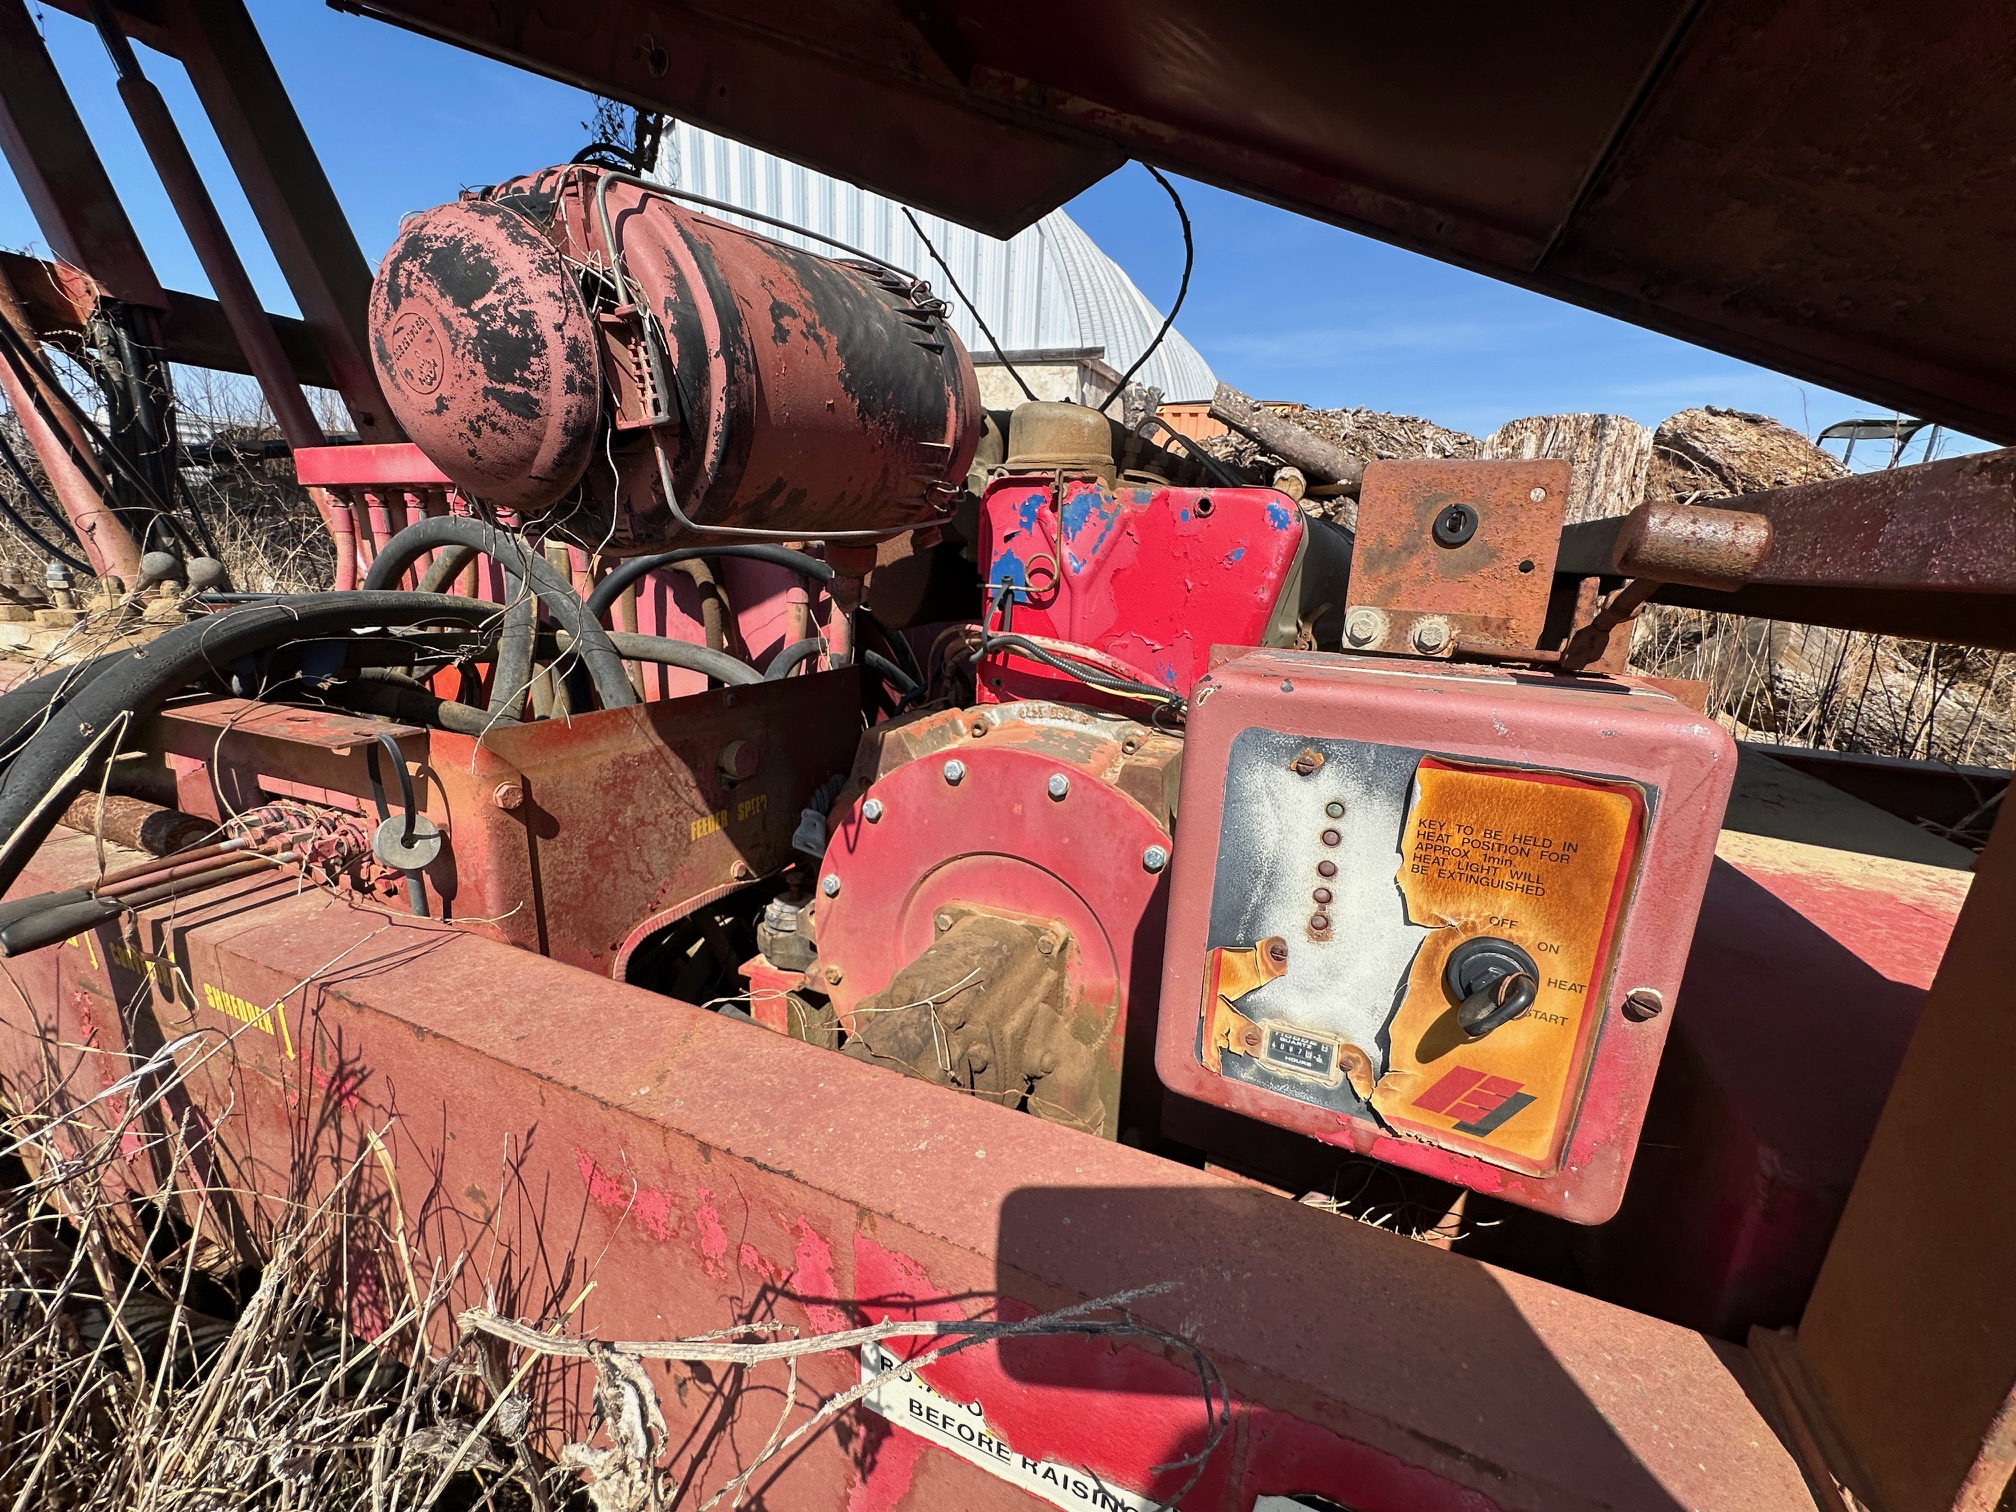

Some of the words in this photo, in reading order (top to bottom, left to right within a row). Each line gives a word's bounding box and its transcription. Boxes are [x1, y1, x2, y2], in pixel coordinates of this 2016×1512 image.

[691, 809, 728, 842] FEEDER
[1418, 818, 1446, 831] KEY
[1456, 824, 1474, 835] TO
[1483, 828, 1502, 840] BE
[1512, 833, 1552, 849] HELD
[1562, 841, 1578, 853] IN
[1415, 841, 1470, 859] APPROX
[1483, 853, 1516, 868] 1min.
[1416, 830, 1452, 844] HEAT
[1461, 837, 1530, 857] POSITION
[1540, 851, 1571, 864] FOR
[1411, 864, 1429, 875] BE
[1438, 868, 1546, 897] EXTINGUISHED
[1412, 852, 1448, 867] HEAT
[1457, 859, 1500, 876] LIGHT
[1509, 869, 1544, 885] WILL
[1489, 916, 1518, 929] OFF
[1537, 941, 1560, 954] ON
[1547, 977, 1587, 993] HEAT
[203, 982, 275, 1036] SHREDDER
[1284, 1055, 1312, 1067] HOURS
[909, 1397, 1011, 1462] BEFORE
